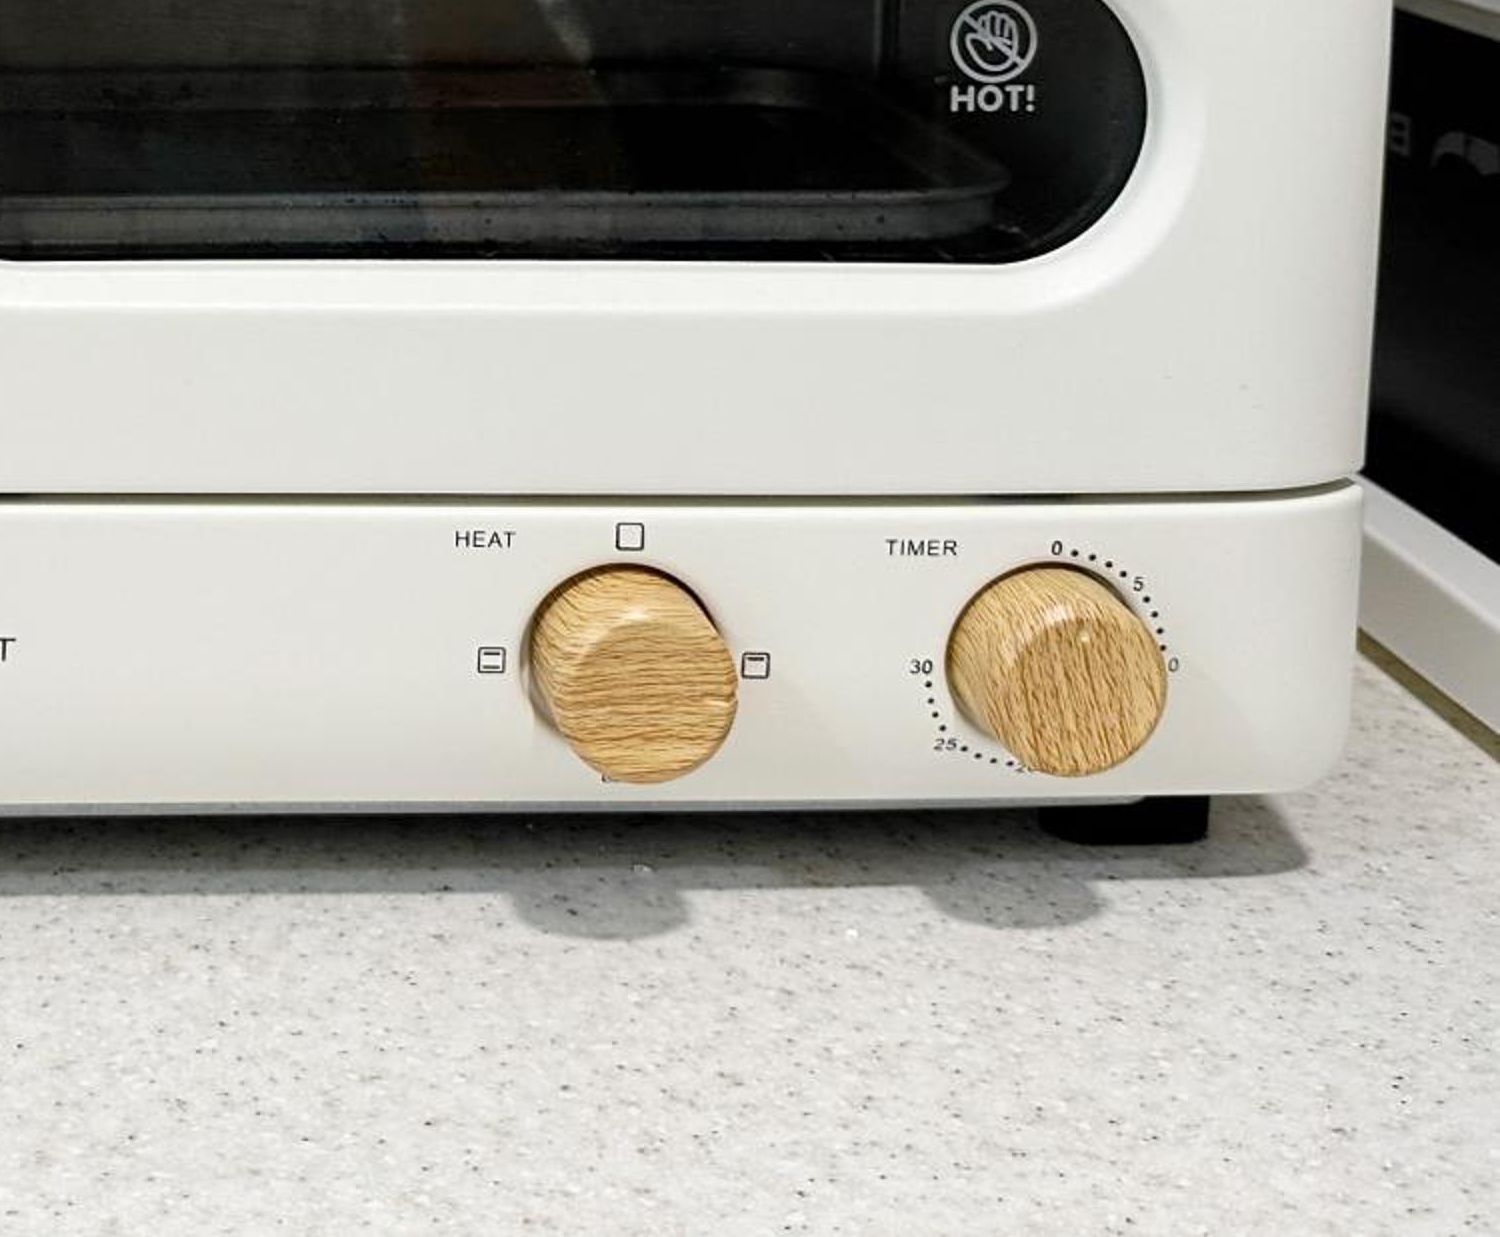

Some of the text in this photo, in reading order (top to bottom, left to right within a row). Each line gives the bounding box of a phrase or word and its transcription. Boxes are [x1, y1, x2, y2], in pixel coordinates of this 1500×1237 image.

[950, 84, 1036, 112] HOT!
[454, 530, 517, 549] HEAT
[884, 539, 959, 557] TIMER
[1050, 540, 1064, 556] 0
[1131, 576, 1145, 593] 5
[909, 659, 934, 676] 30
[932, 736, 960, 752] 25
